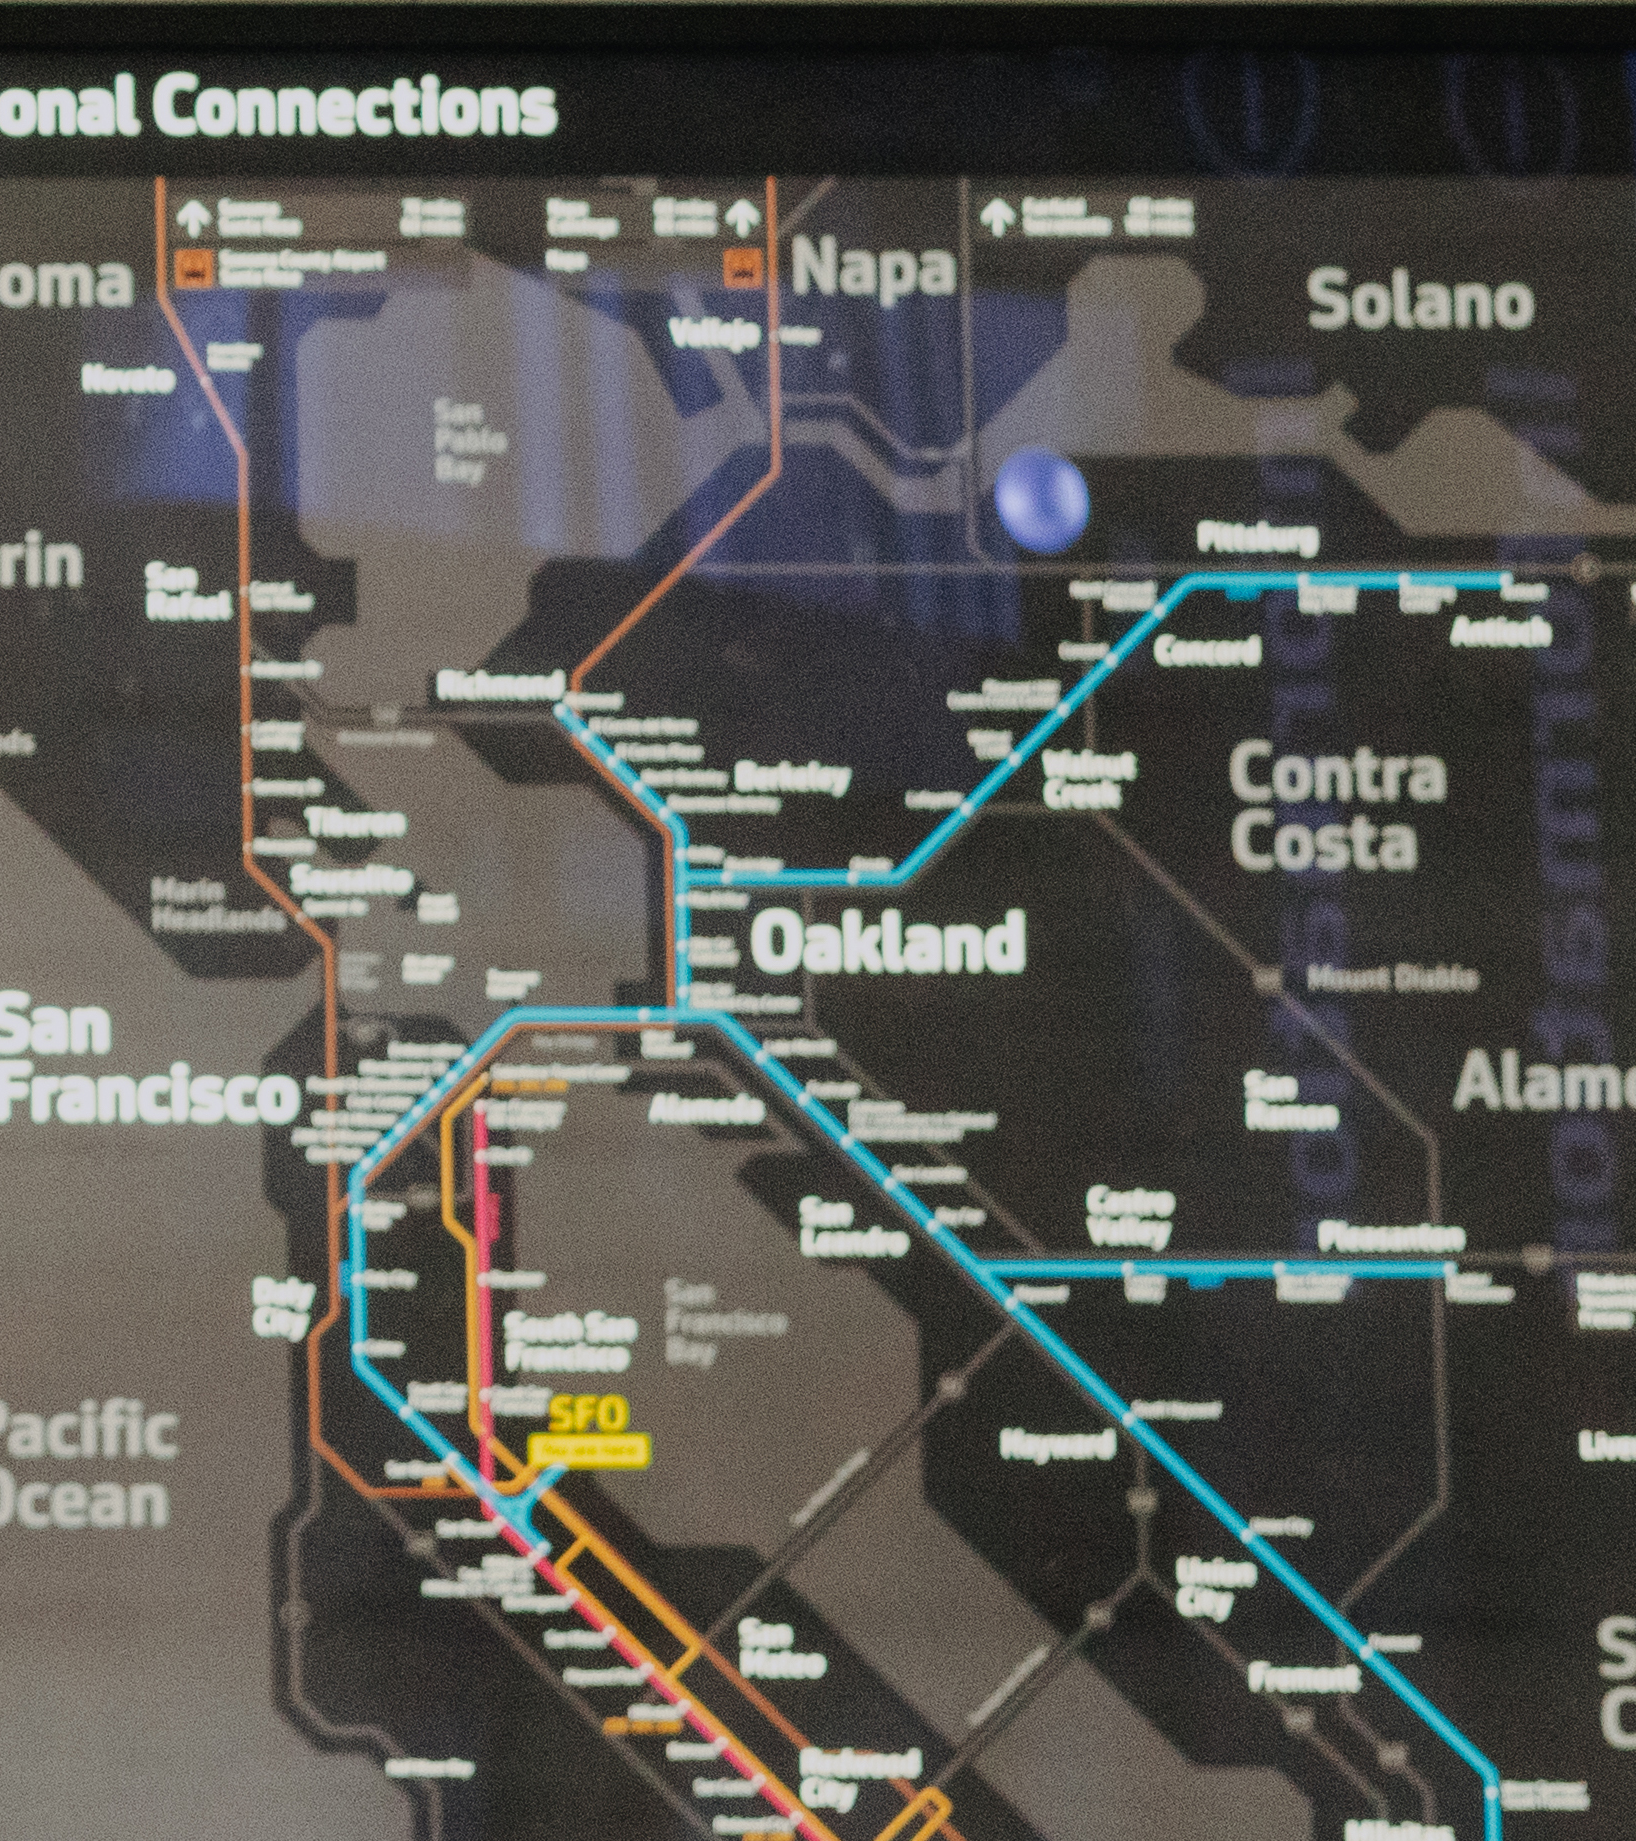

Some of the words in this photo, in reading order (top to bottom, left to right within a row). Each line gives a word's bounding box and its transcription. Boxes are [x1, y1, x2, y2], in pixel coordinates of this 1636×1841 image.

[152, 71, 558, 137] Connections
[792, 235, 956, 311] Napa
[1307, 267, 1535, 329] Solano
[436, 666, 565, 702] Richmond
[731, 760, 852, 797] Berkeley
[1230, 739, 1447, 803] Contra
[1232, 808, 1417, 873] Costa
[750, 907, 1026, 975] Oakland
[551, 1395, 628, 1433] SFO
